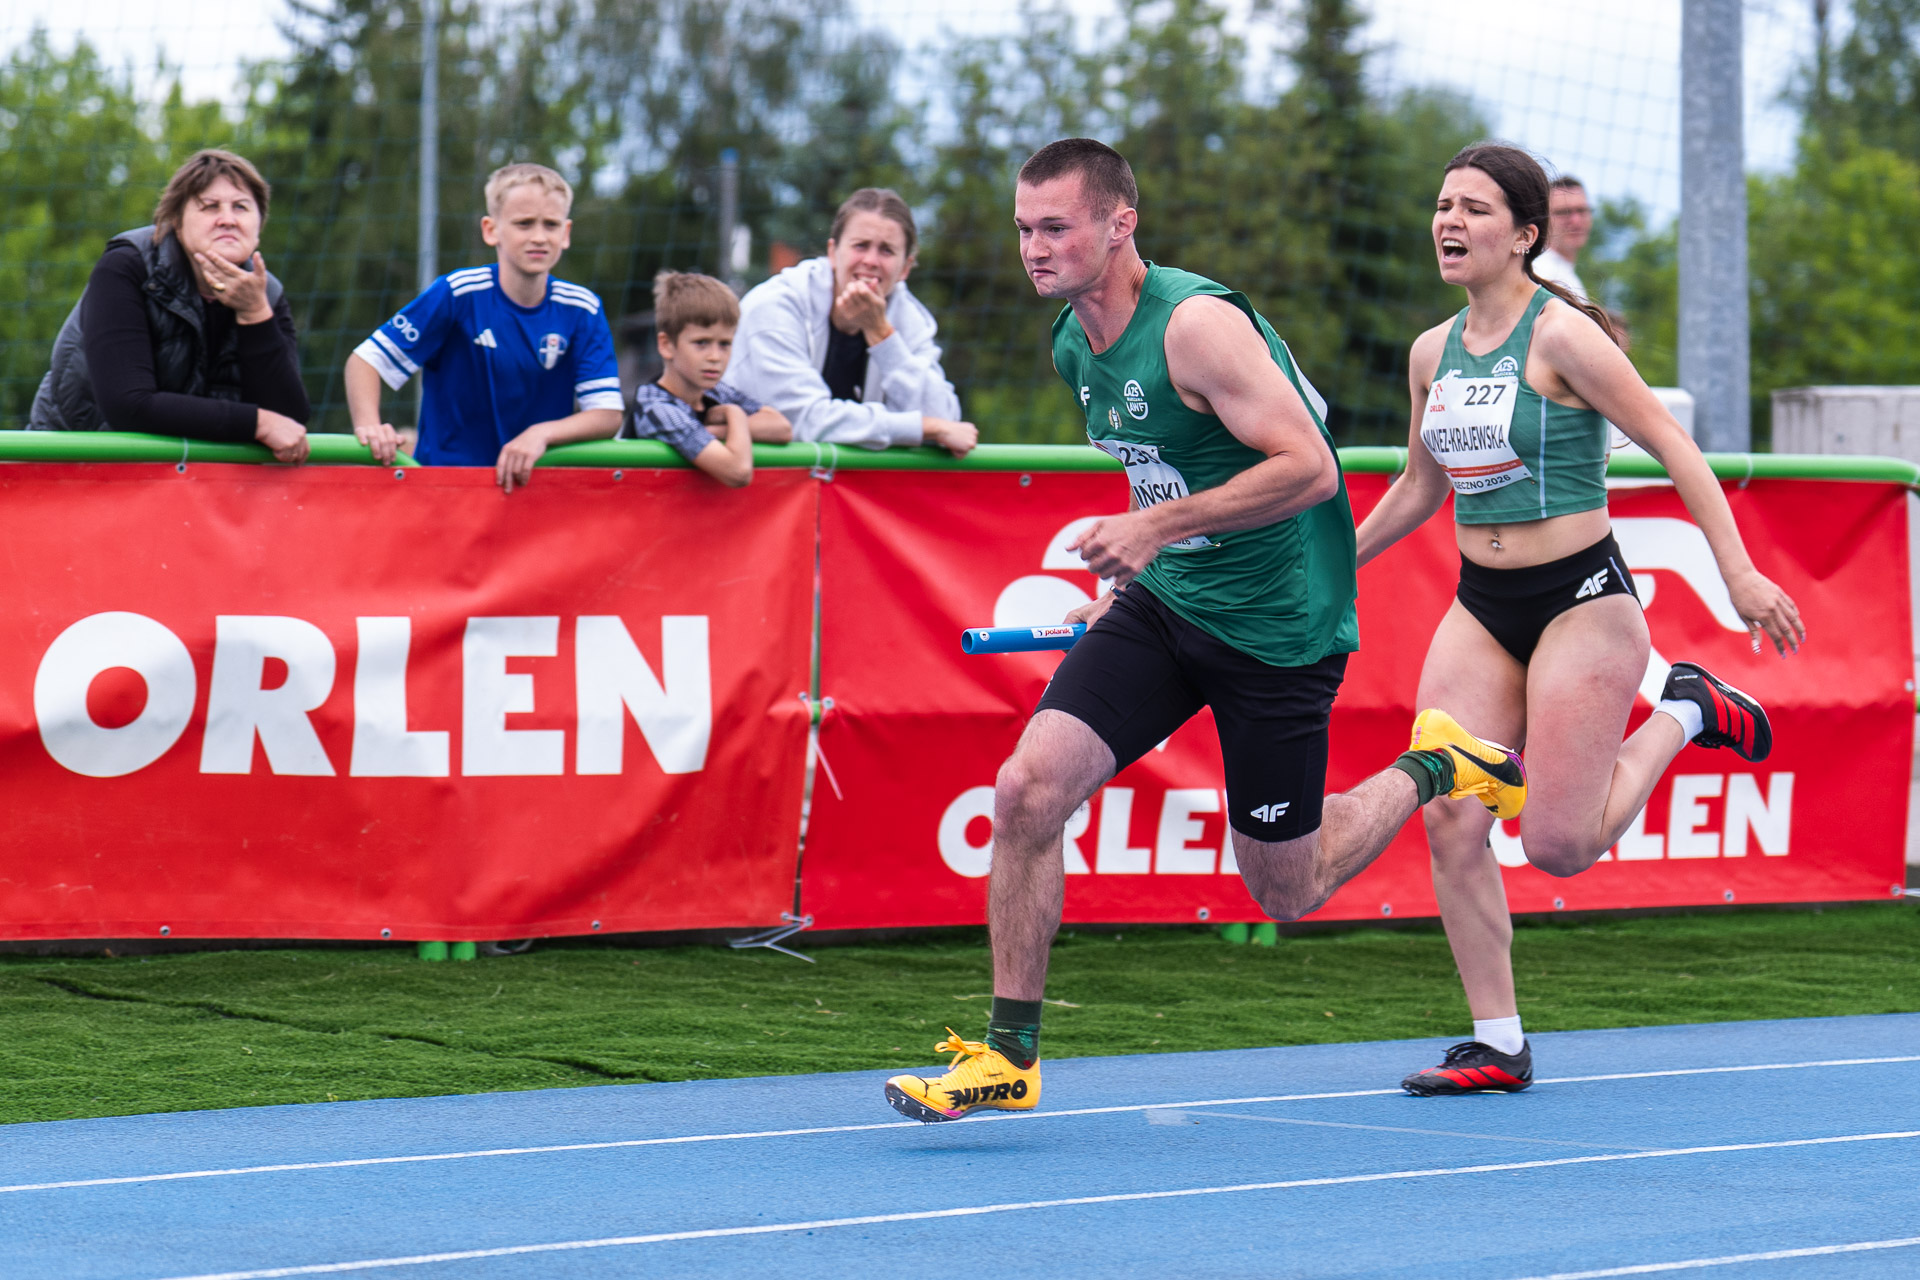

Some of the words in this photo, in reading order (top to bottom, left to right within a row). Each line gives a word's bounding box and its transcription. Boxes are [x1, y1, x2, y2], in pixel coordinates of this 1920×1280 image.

[1464, 384, 1507, 406] 227
[1132, 478, 1183, 509] IŃSKI
[1485, 474, 1511, 487] 2026
[1575, 568, 1608, 599] 4F
[33, 610, 713, 777] ORLEN
[1250, 801, 1291, 823] 4F
[938, 786, 1241, 878] OLE
[943, 1078, 1028, 1112] NITRO
